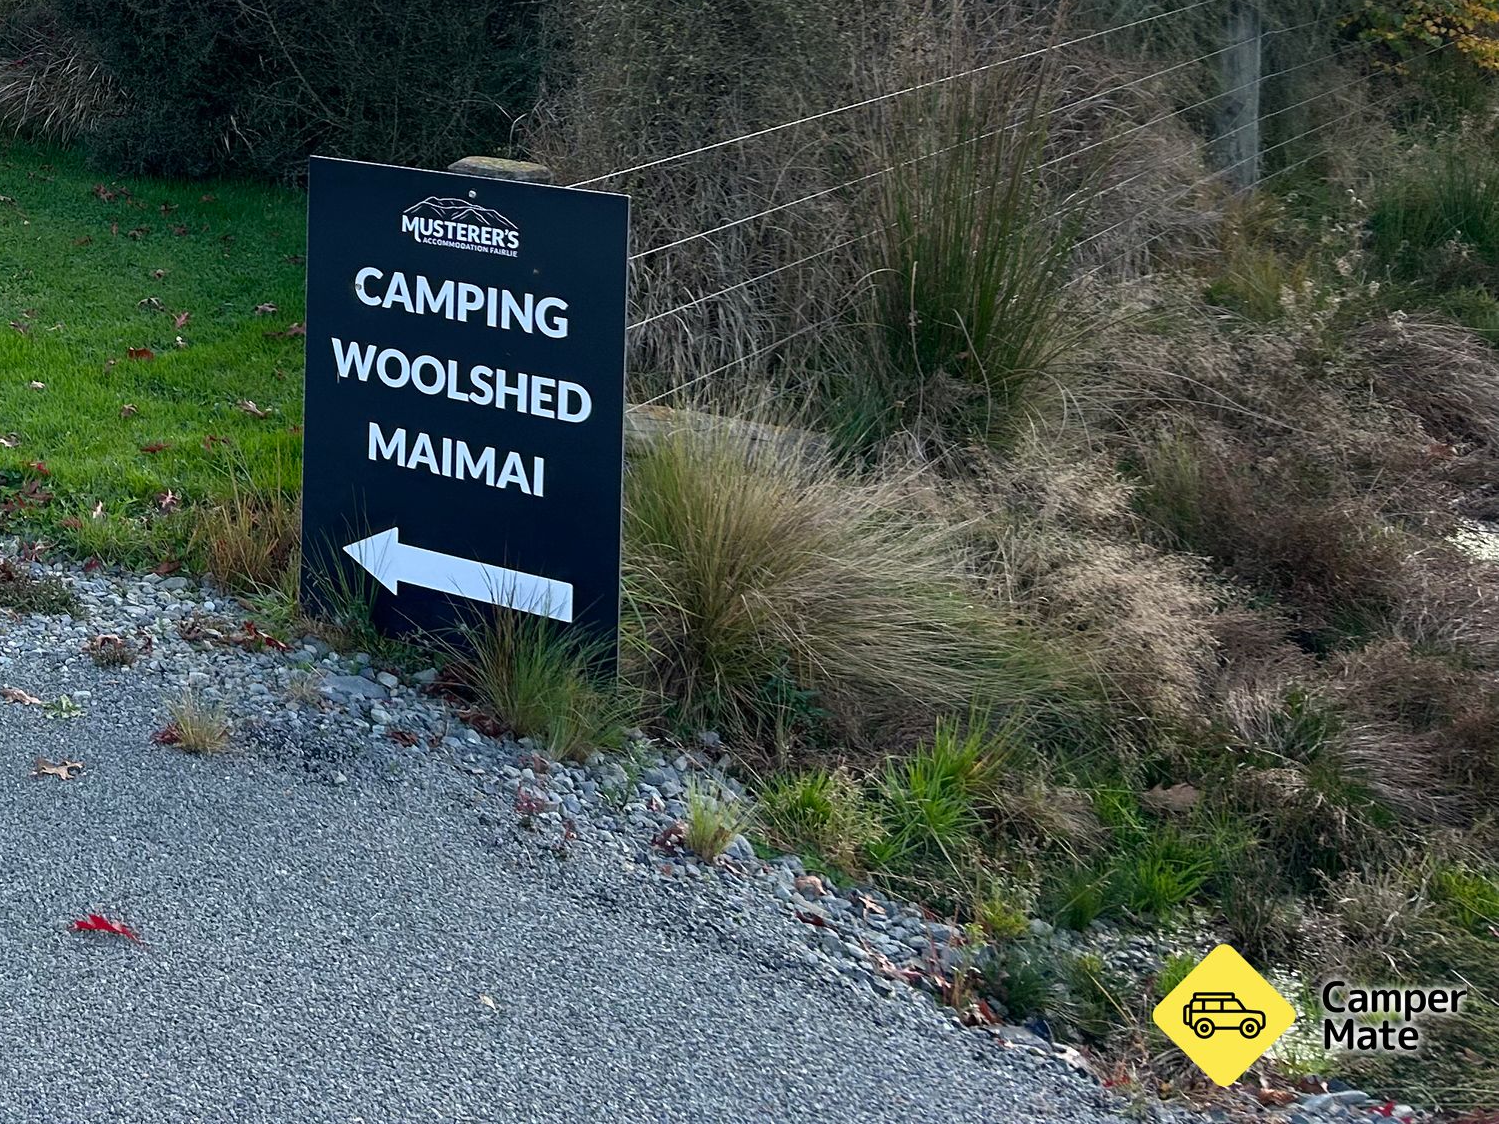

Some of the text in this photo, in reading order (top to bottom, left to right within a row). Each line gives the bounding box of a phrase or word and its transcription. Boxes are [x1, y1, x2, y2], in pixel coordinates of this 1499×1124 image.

[402, 215, 519, 249] MUSTERER'S
[422, 237, 518, 257] ACCOMMODATION FAIRLIE
[355, 267, 569, 339] CAMPING
[331, 337, 592, 424] WOOLSHED
[368, 422, 544, 497] MAIMAI
